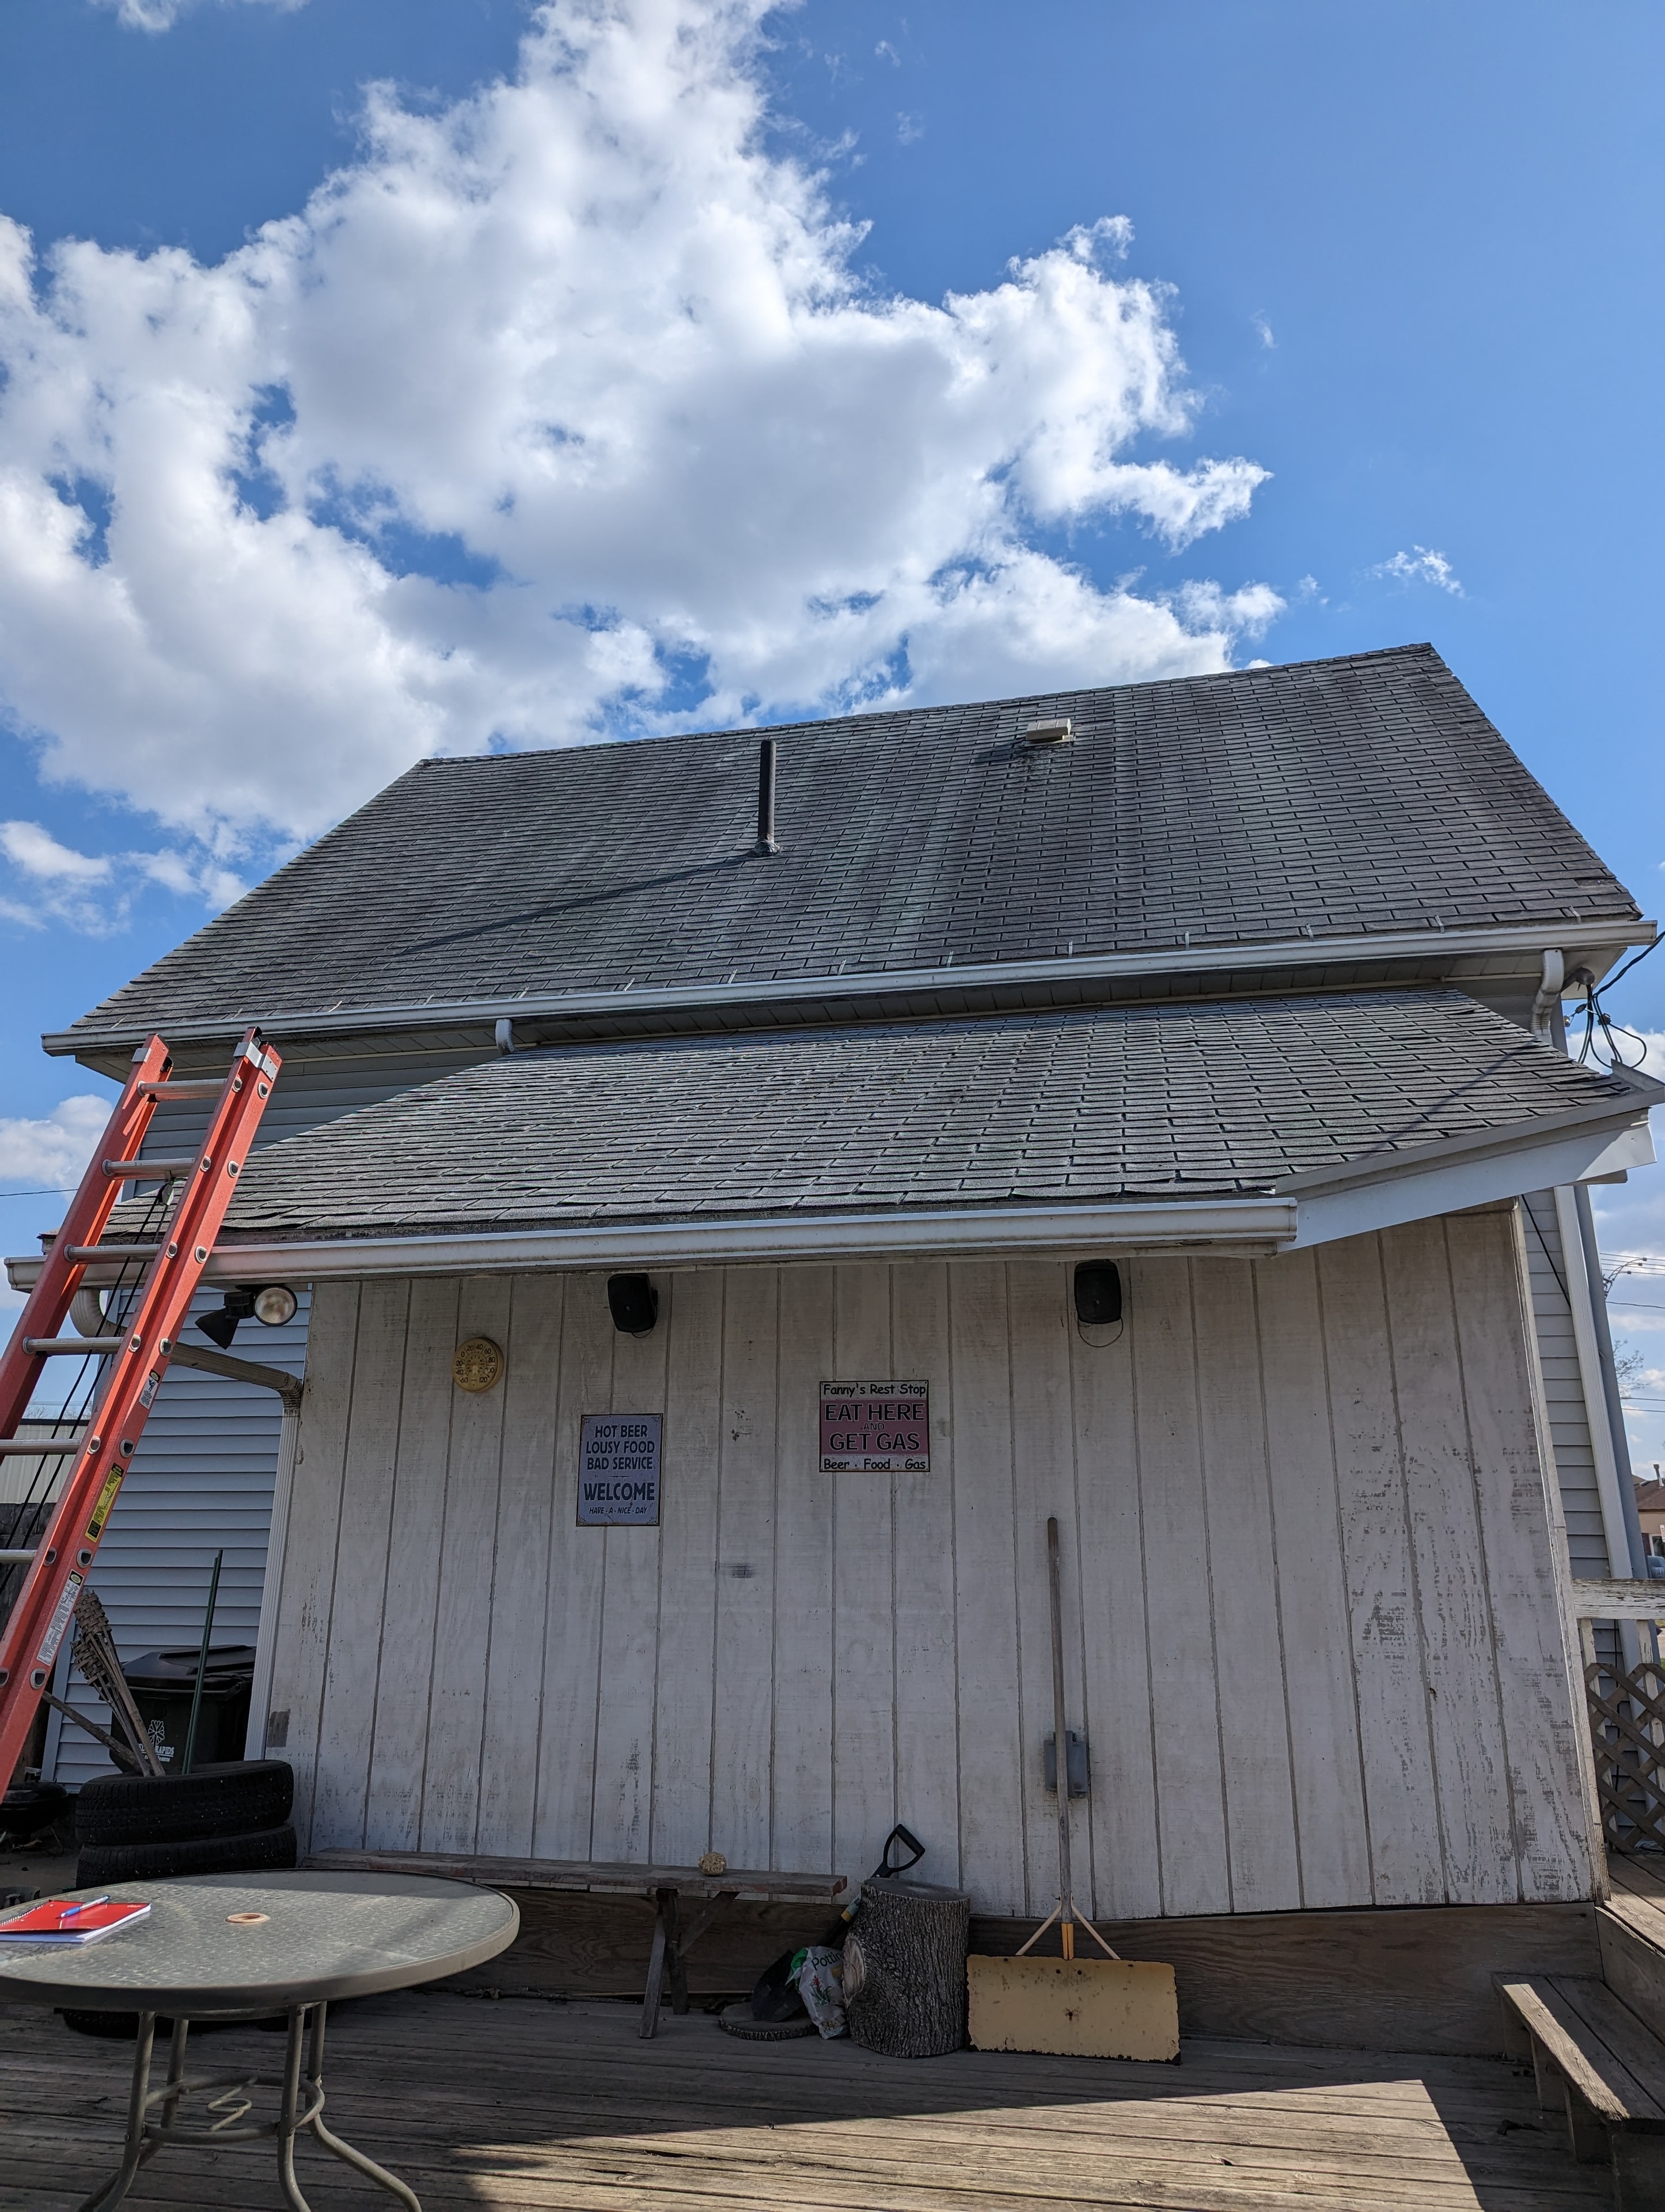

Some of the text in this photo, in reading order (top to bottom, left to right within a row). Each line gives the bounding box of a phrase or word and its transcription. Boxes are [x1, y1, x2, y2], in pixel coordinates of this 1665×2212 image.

[824, 1382, 926, 1398] Fanny's Rest Stop
[825, 1403, 924, 1421] EAT HERE
[595, 1425, 648, 1438] HOT BEER
[863, 1422, 885, 1430] AND
[586, 1441, 655, 1454] LOUSY FOOD
[829, 1433, 920, 1450] GET GAS
[587, 1457, 653, 1470] BAD SERVICE
[824, 1458, 926, 1469] Beer Food Gas
[583, 1483, 655, 1501] WELCOME
[155, 1745, 175, 1755] RAPIDS
[811, 1952, 844, 1971] Pottin
